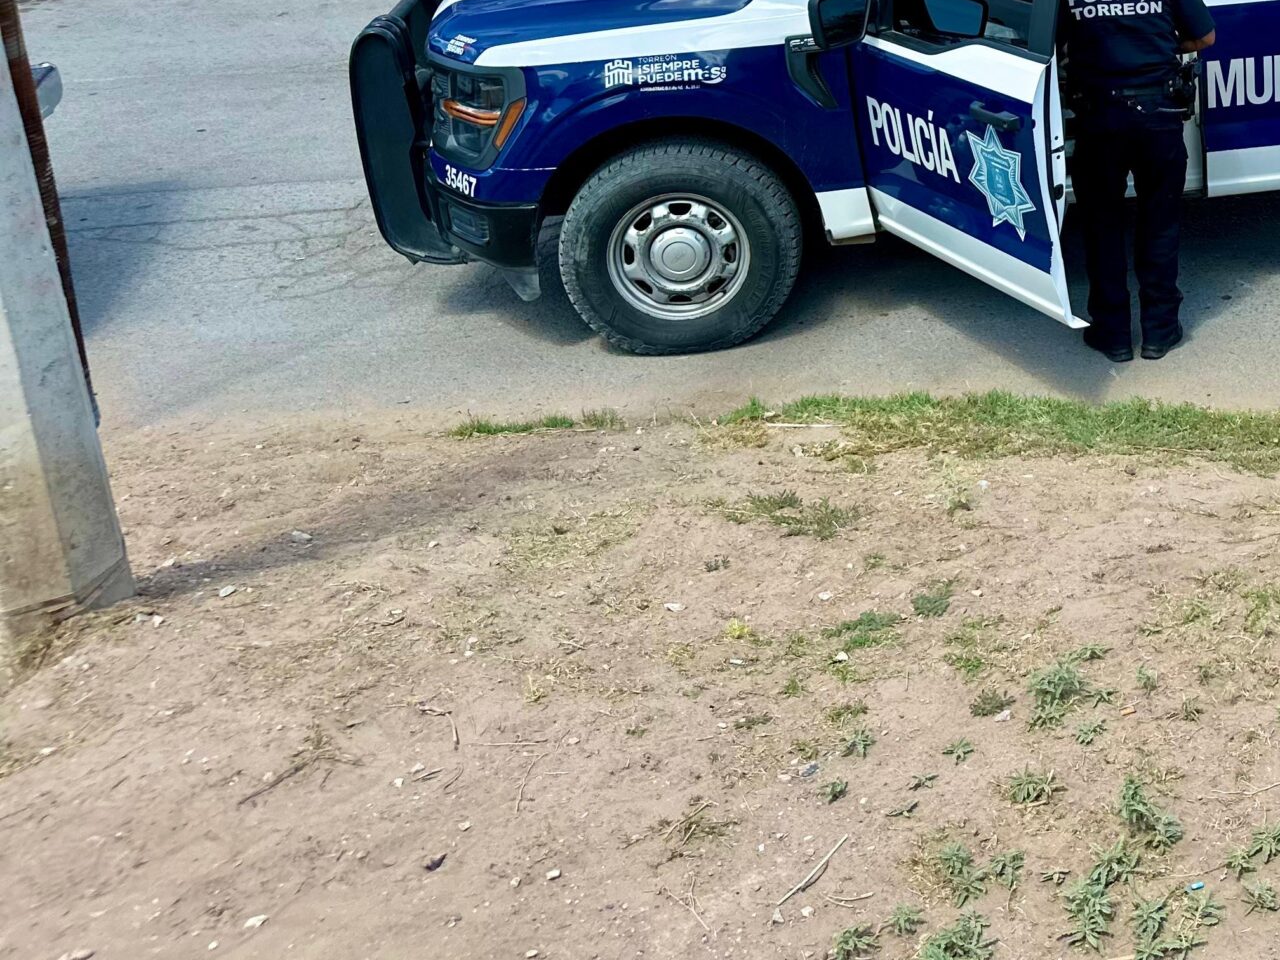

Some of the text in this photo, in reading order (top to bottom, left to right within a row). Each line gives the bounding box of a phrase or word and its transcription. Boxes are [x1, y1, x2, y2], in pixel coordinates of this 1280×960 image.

[1071, 0, 1163, 20] TORREÓN
[638, 55, 676, 63] TORREÓN
[866, 96, 961, 184] POLICÍA
[446, 164, 477, 197] 35467
